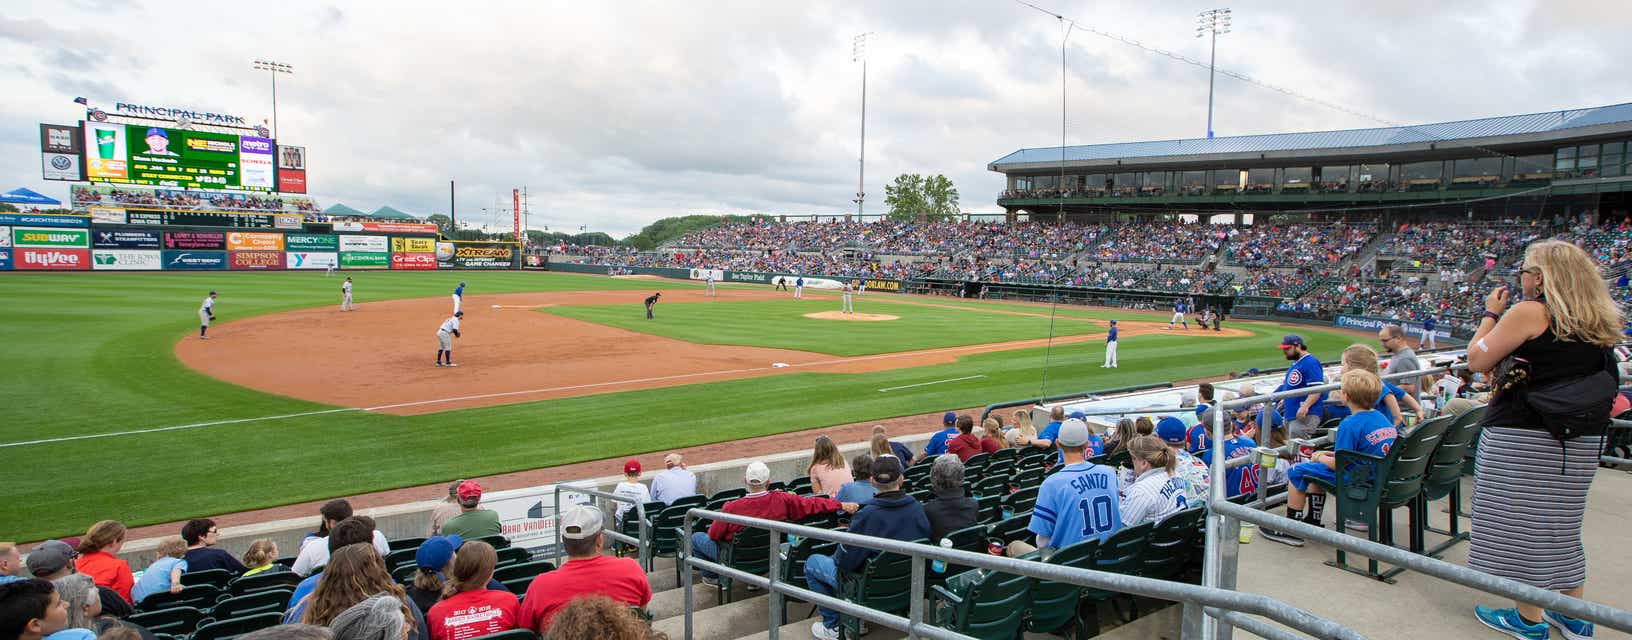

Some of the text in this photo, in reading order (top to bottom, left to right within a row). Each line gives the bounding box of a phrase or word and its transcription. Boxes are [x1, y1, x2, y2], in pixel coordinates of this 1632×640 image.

[116, 102, 245, 124] PRINCIPAL PARK
[22, 233, 80, 242] SUBWAY
[456, 248, 510, 258] XTREAM
[1345, 317, 1376, 328] Principal
[1071, 473, 1108, 494] SANTO
[1079, 495, 1113, 537] 10
[502, 523, 521, 535] BRAD
